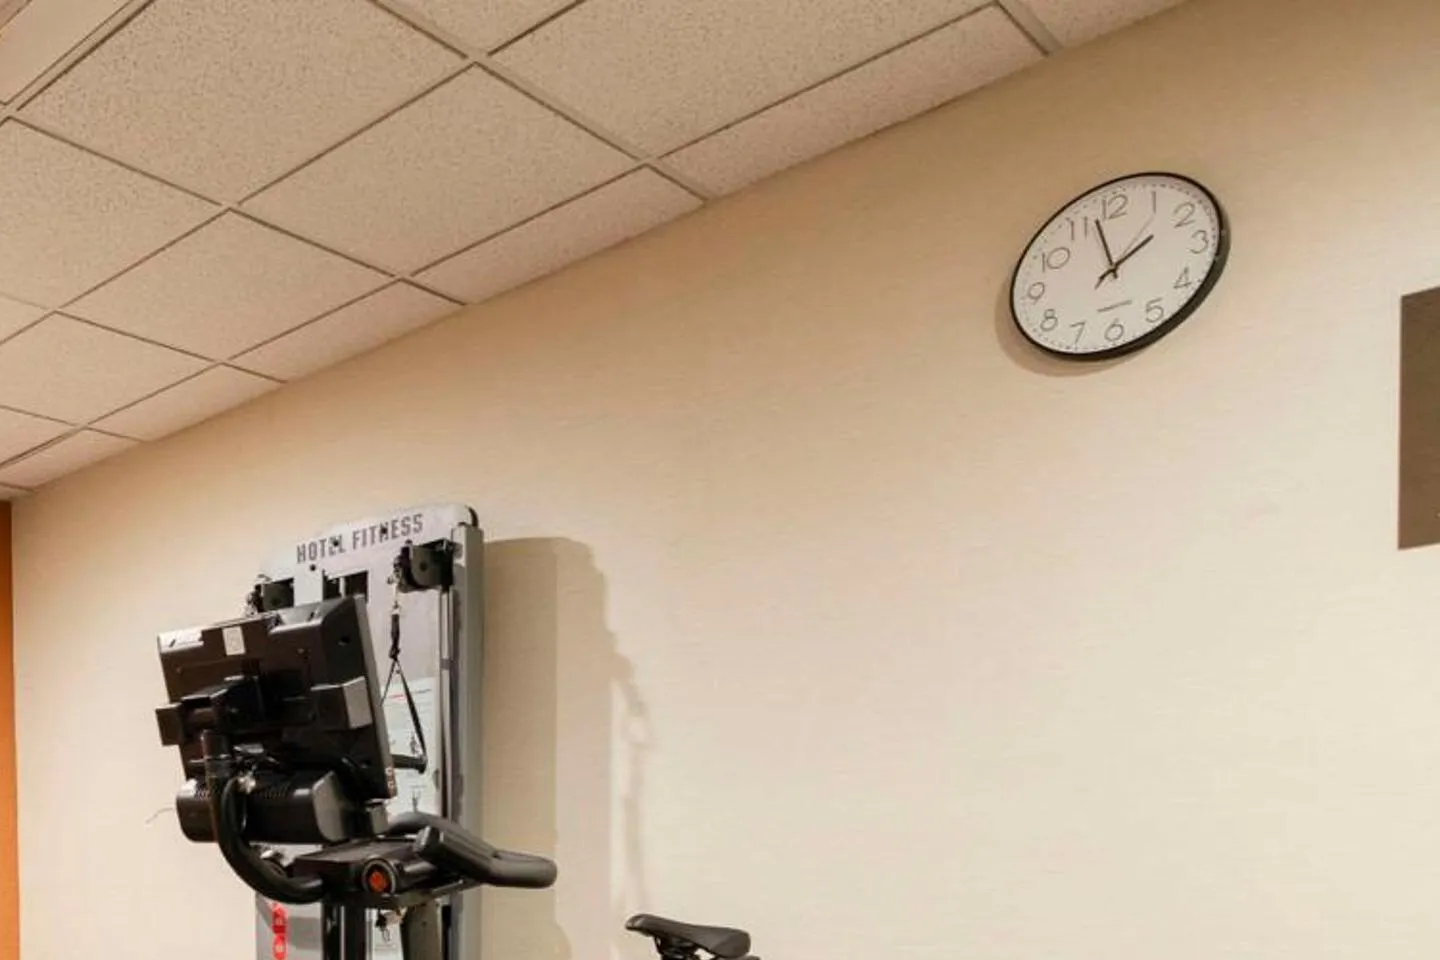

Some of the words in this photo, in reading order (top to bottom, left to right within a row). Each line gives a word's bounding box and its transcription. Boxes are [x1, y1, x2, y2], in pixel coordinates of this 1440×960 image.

[1101, 192, 1129, 220] 12
[1172, 201, 1197, 229] 2
[1065, 215, 1089, 241] 11
[1189, 230, 1209, 254] 3
[1040, 245, 1071, 273] 10
[1173, 266, 1192, 289] 4
[1026, 281, 1046, 305] 9
[1039, 308, 1059, 332] 8
[1144, 297, 1165, 323] 5
[1068, 320, 1087, 346] 7
[1103, 316, 1125, 342] 6
[296, 533, 347, 564] HOTEL
[352, 511, 424, 551] FITNESS
